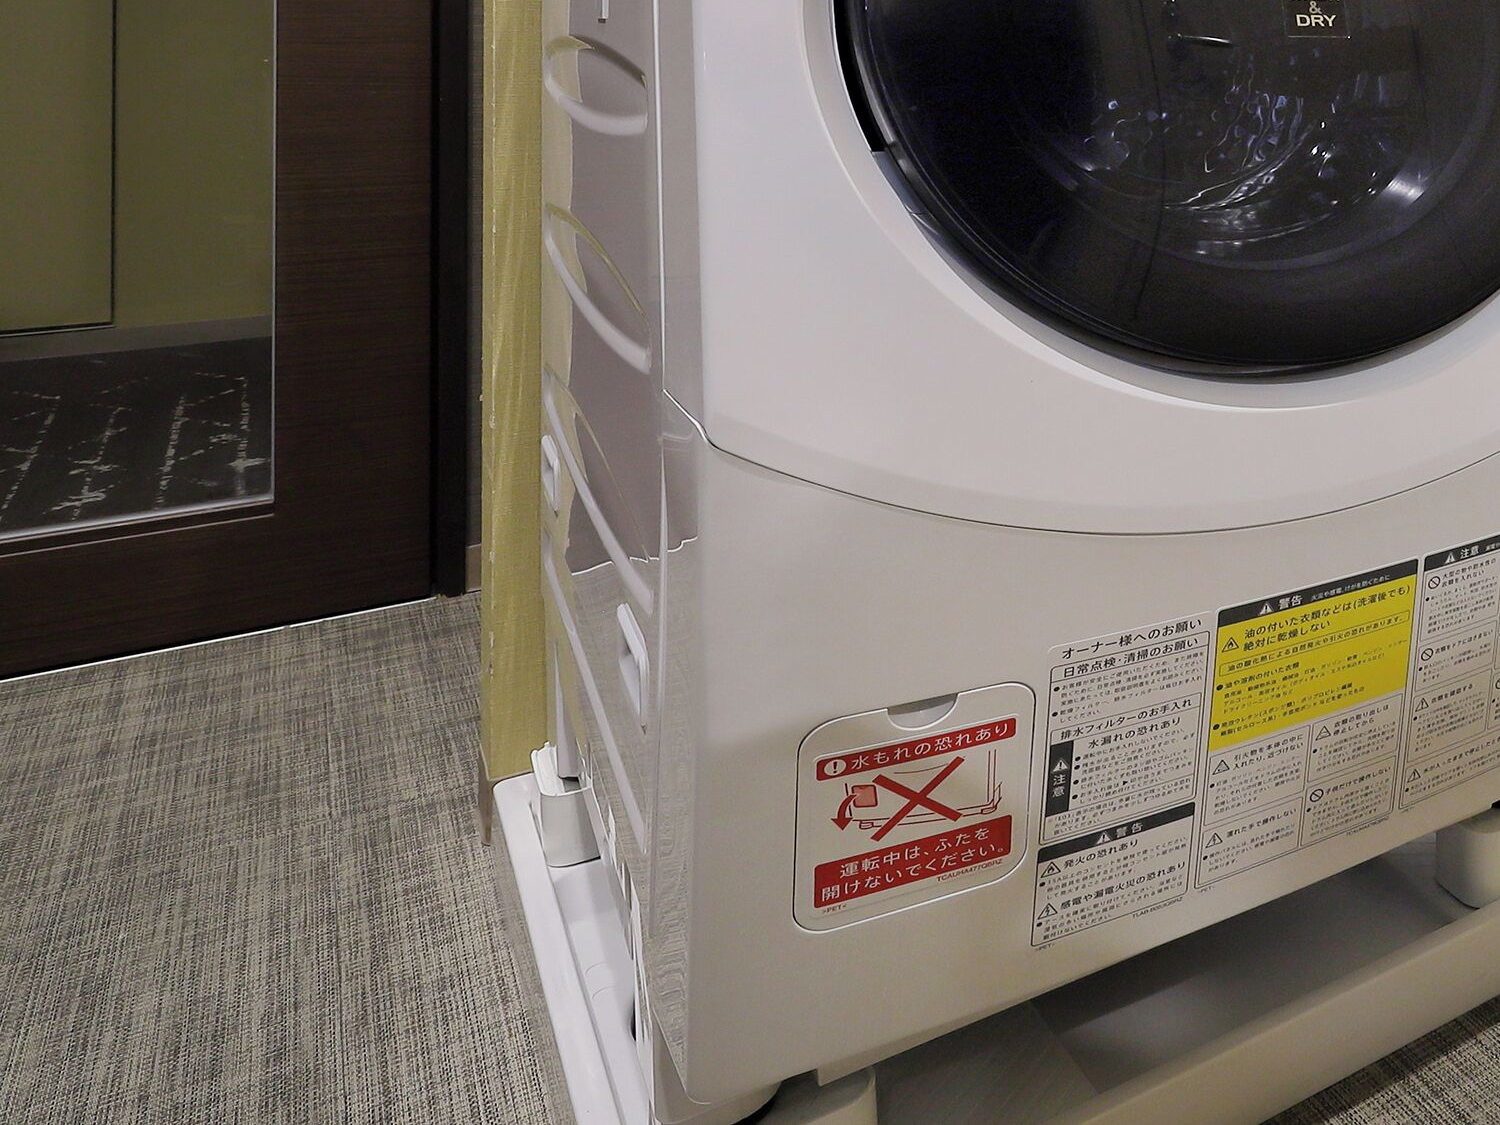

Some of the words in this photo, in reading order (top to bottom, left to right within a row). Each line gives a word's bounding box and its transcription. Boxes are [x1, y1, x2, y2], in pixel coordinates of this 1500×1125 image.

[1296, 14, 1336, 27] DRY
[1309, 1, 1322, 14] &
[1277, 593, 1303, 611] 警告
[1061, 614, 1202, 663] オーナー様へのお願い
[1242, 619, 1330, 652] 絶対に乾燥しない
[1063, 634, 1198, 680] 日常点検・清掃のお願い
[1060, 696, 1191, 741] 排水フィルターのお手入れ
[1087, 715, 1181, 750] 水漏れの恐れあり
[851, 724, 1007, 770] 水もれの恐れあり
[821, 840, 1003, 902] 開けないでください。
[839, 826, 989, 879] 運転中は、ふたを
[1063, 838, 1138, 869] 発火の恐れあり
